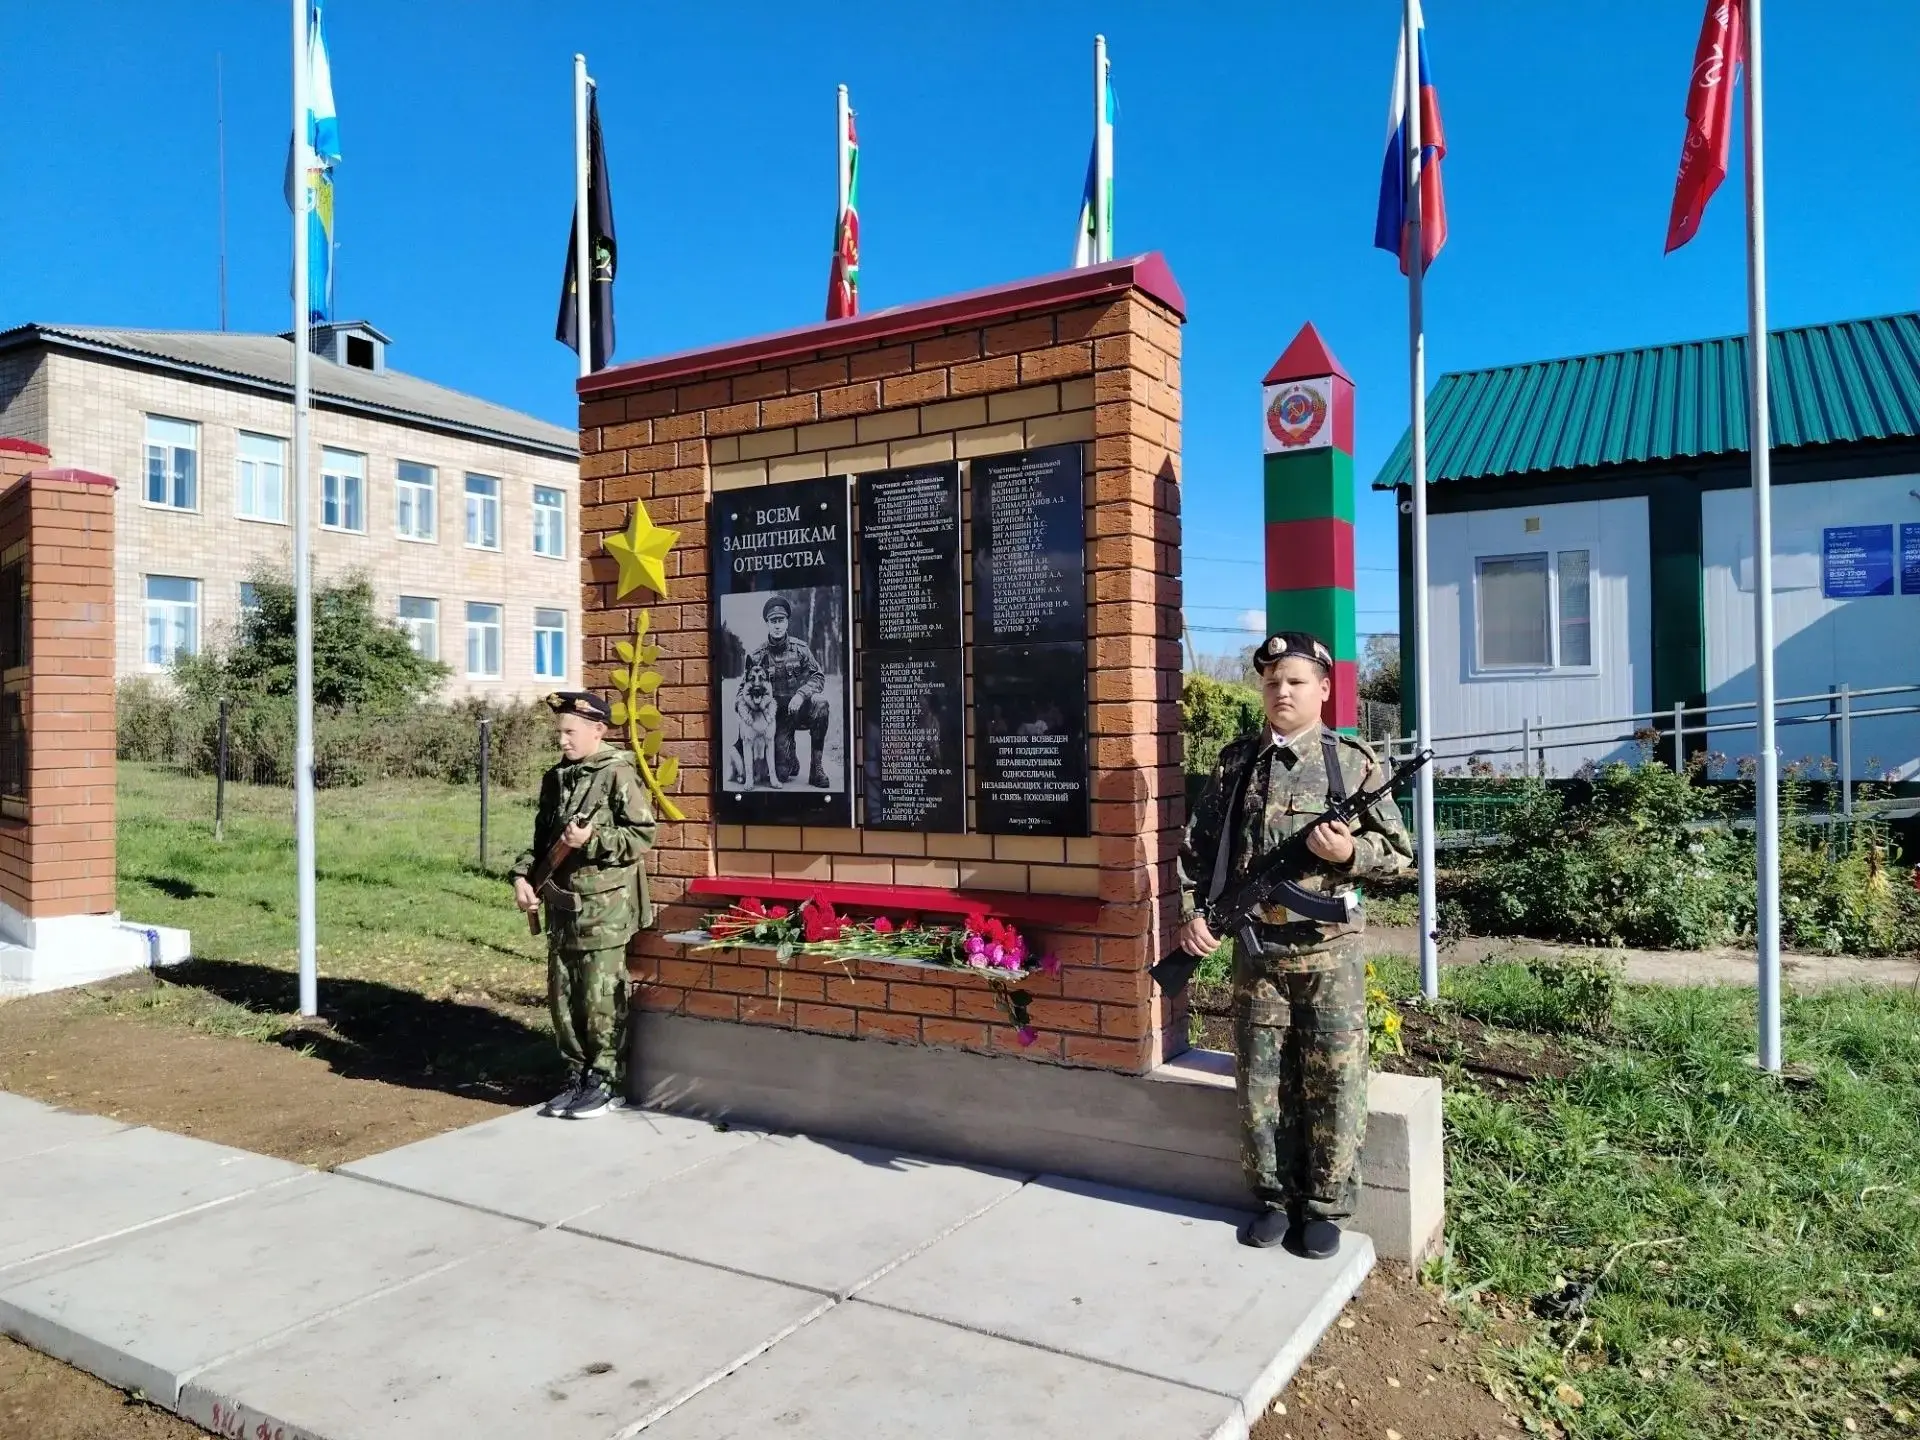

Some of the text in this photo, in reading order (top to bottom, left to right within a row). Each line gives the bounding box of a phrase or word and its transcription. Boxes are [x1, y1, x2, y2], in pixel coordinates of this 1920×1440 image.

[756, 506, 800, 525] ВСЕМ
[723, 525, 836, 551] ЗАЩИТНИКАМ
[734, 550, 825, 573] ОТЕЧЕСТВА
[1031, 735, 1068, 743] ВОЗВЕДЕН
[1016, 747, 1059, 755] ПОДДЕРЖКЕ
[1024, 793, 1068, 801] ПОКОЛЕНИЙ
